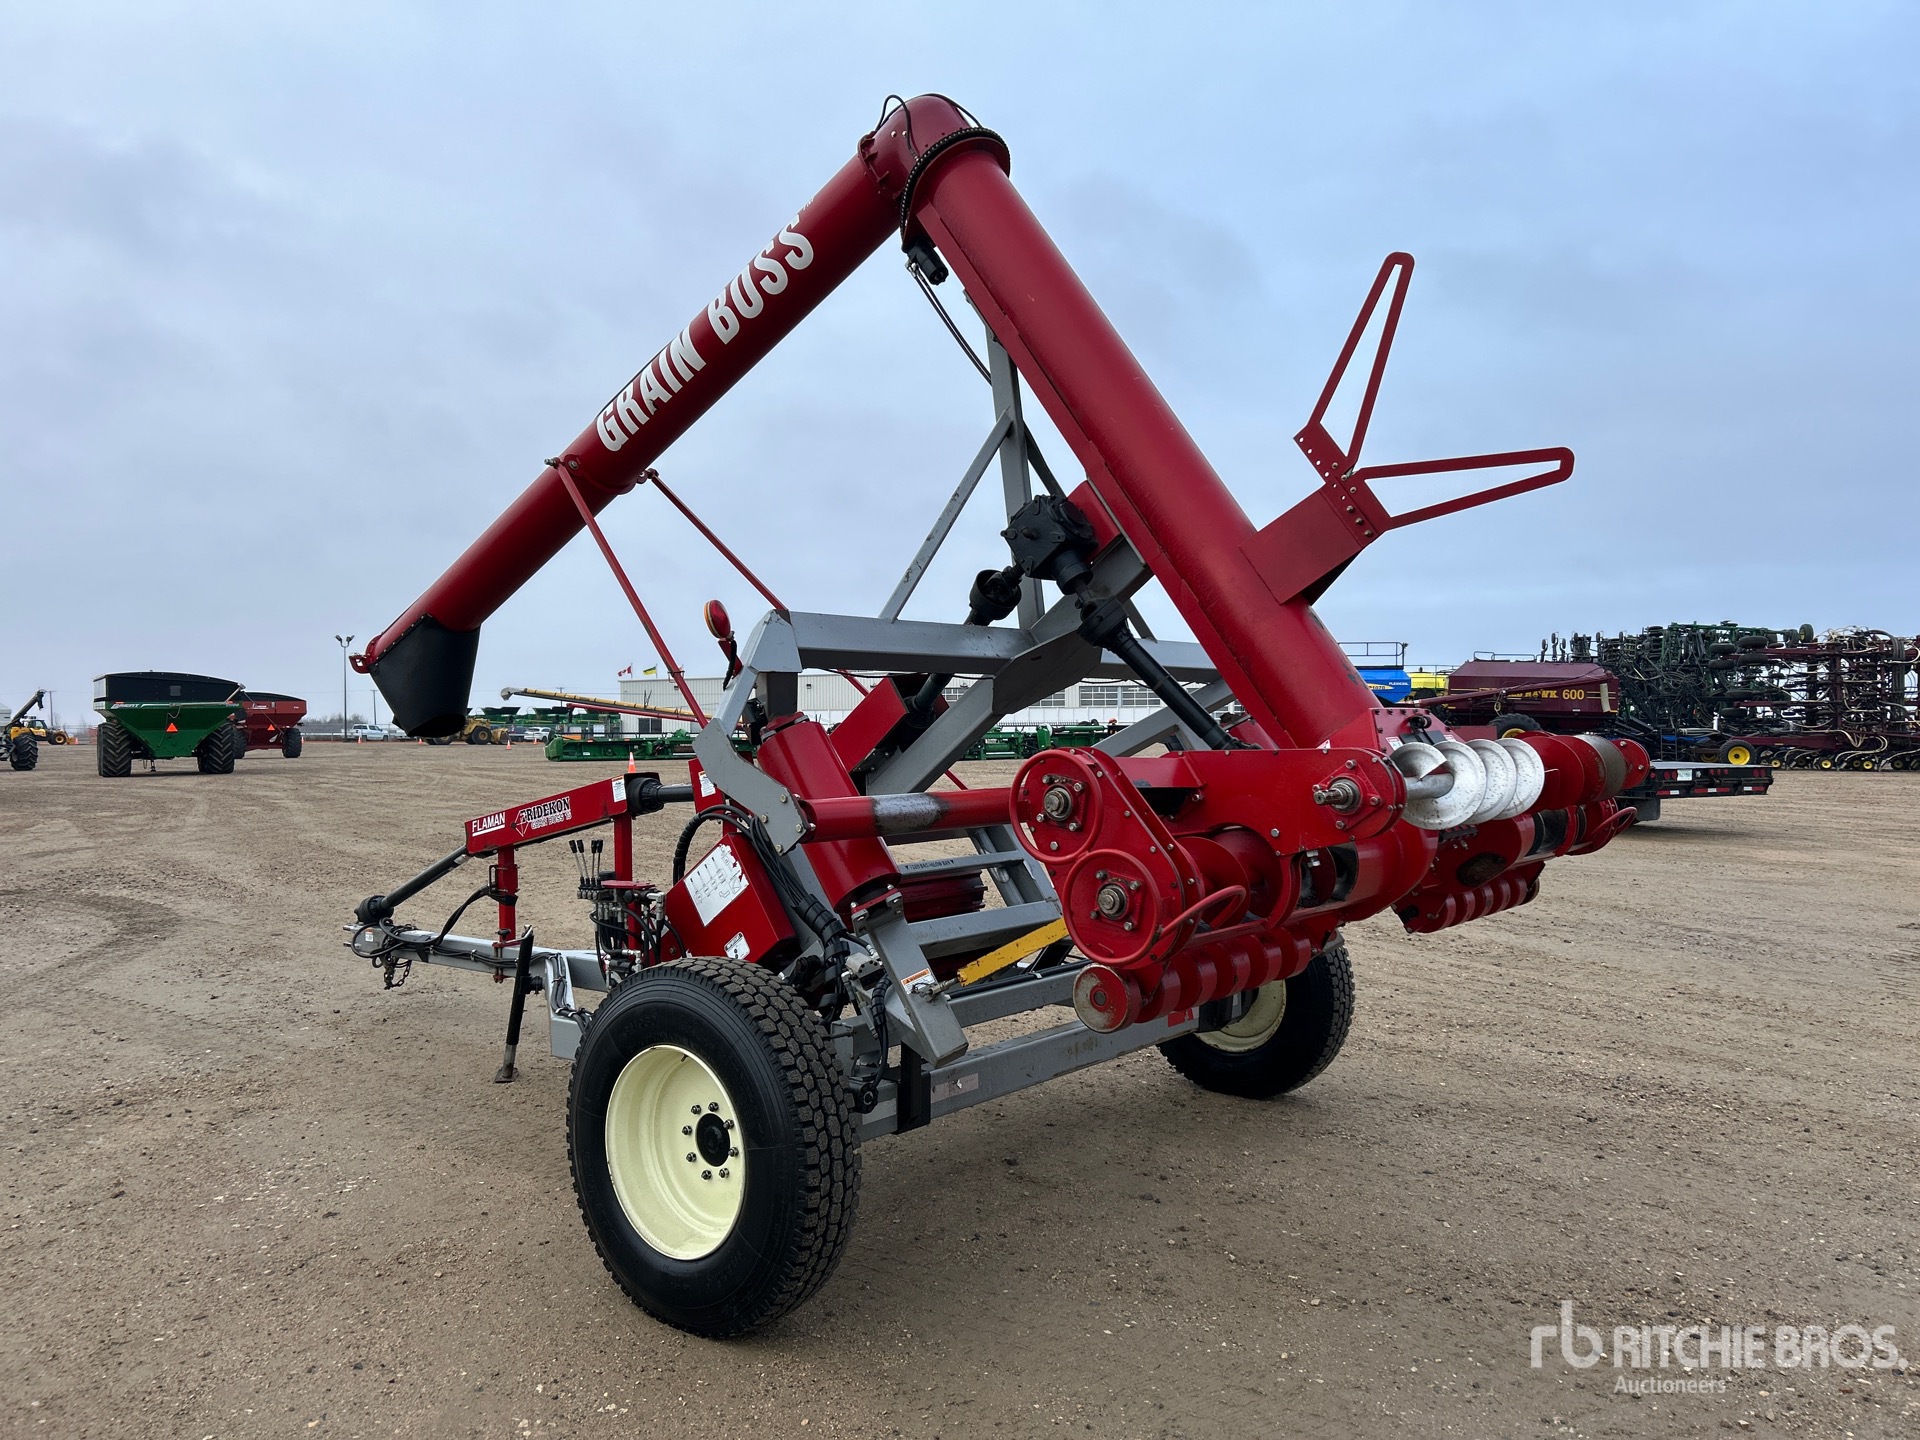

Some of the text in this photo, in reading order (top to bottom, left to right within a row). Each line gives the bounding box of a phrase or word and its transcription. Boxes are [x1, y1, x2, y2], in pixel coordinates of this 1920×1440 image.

[596, 213, 814, 452] GRAIN BOSS
[1562, 689, 1585, 700] 600
[519, 796, 570, 823] TRIDEKON
[471, 812, 506, 833] FLAMAN
